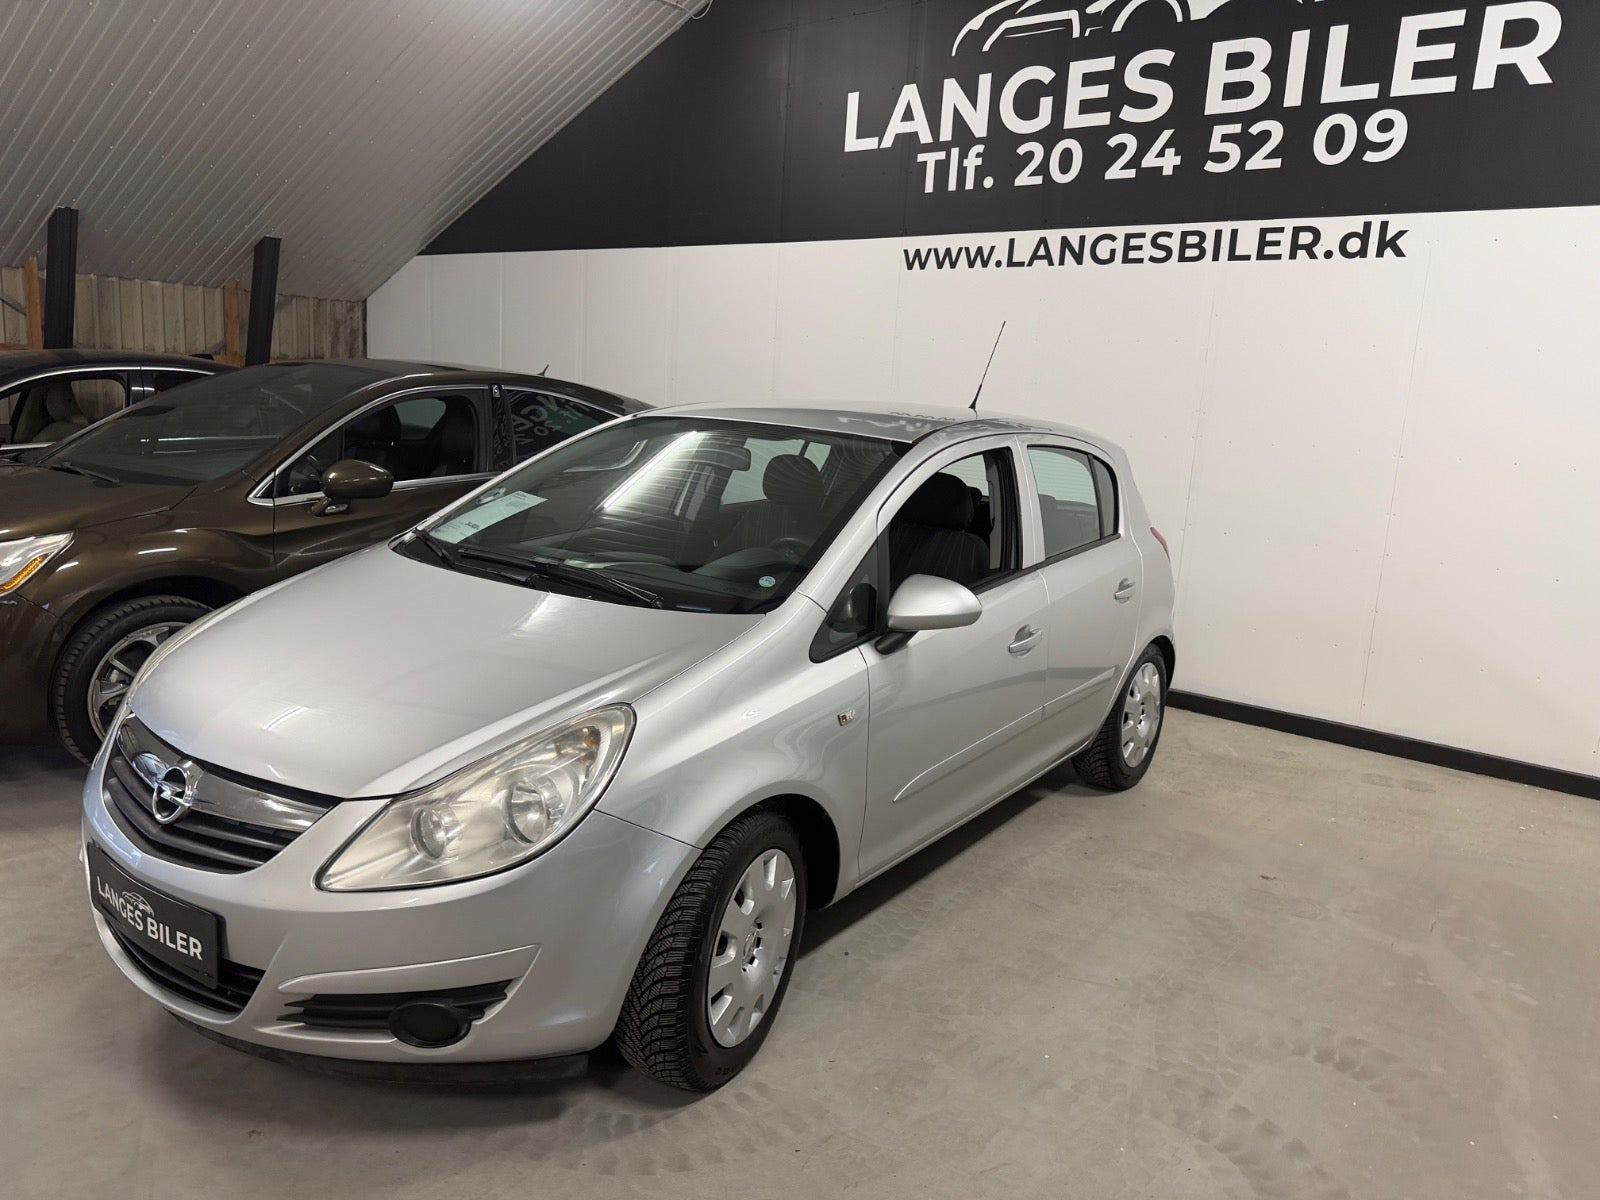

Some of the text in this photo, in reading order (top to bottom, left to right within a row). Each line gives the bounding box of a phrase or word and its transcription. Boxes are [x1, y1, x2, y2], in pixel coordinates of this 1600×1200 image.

[843, 0, 1562, 153] LANGES BILER
[916, 108, 1408, 194] Tlf. 20 24 52 09
[903, 220, 1410, 272] www.LANGESBILER.dk
[96, 875, 203, 961] LANGES BILER
